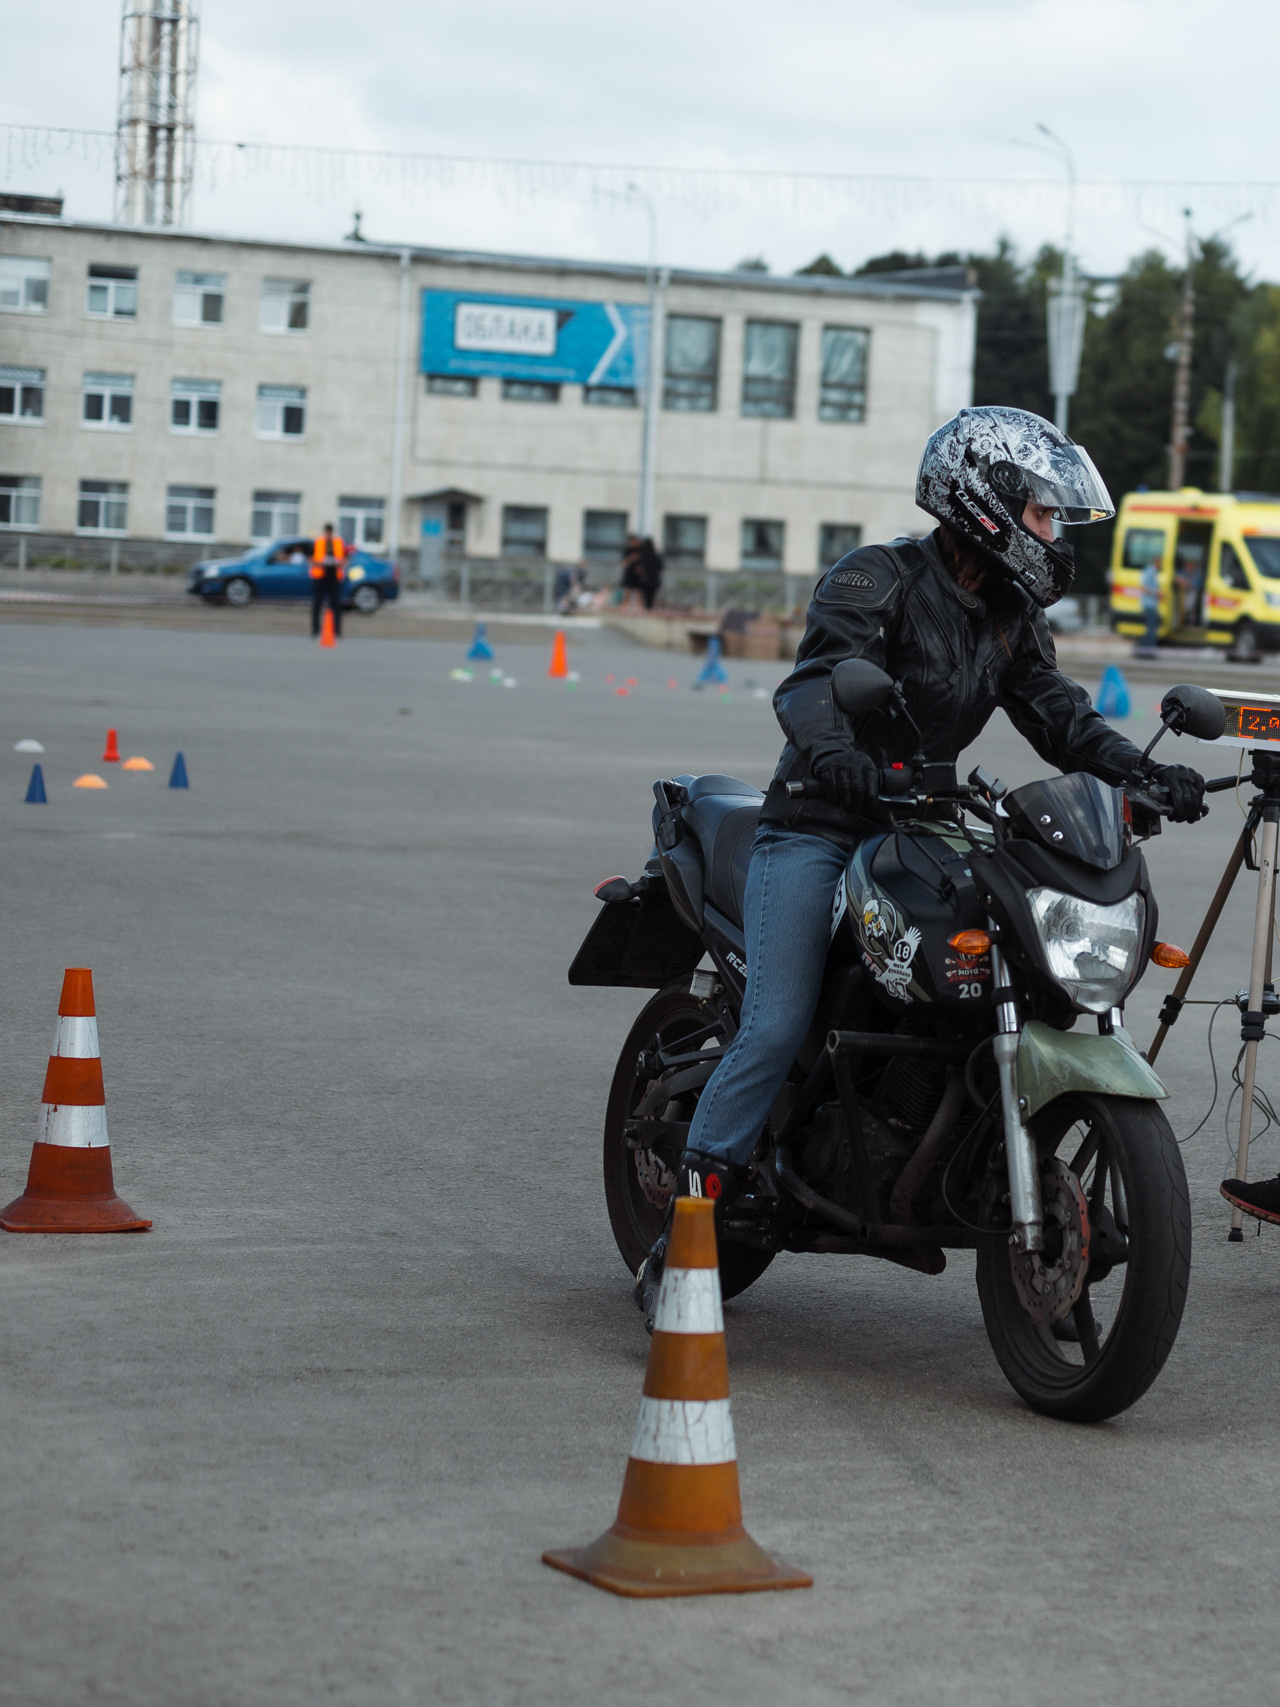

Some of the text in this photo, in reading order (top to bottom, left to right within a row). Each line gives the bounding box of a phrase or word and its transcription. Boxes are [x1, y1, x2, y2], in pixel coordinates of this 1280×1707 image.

[896, 943, 910, 959] 18
[958, 968, 979, 976] MOTO
[959, 983, 982, 999] 20
